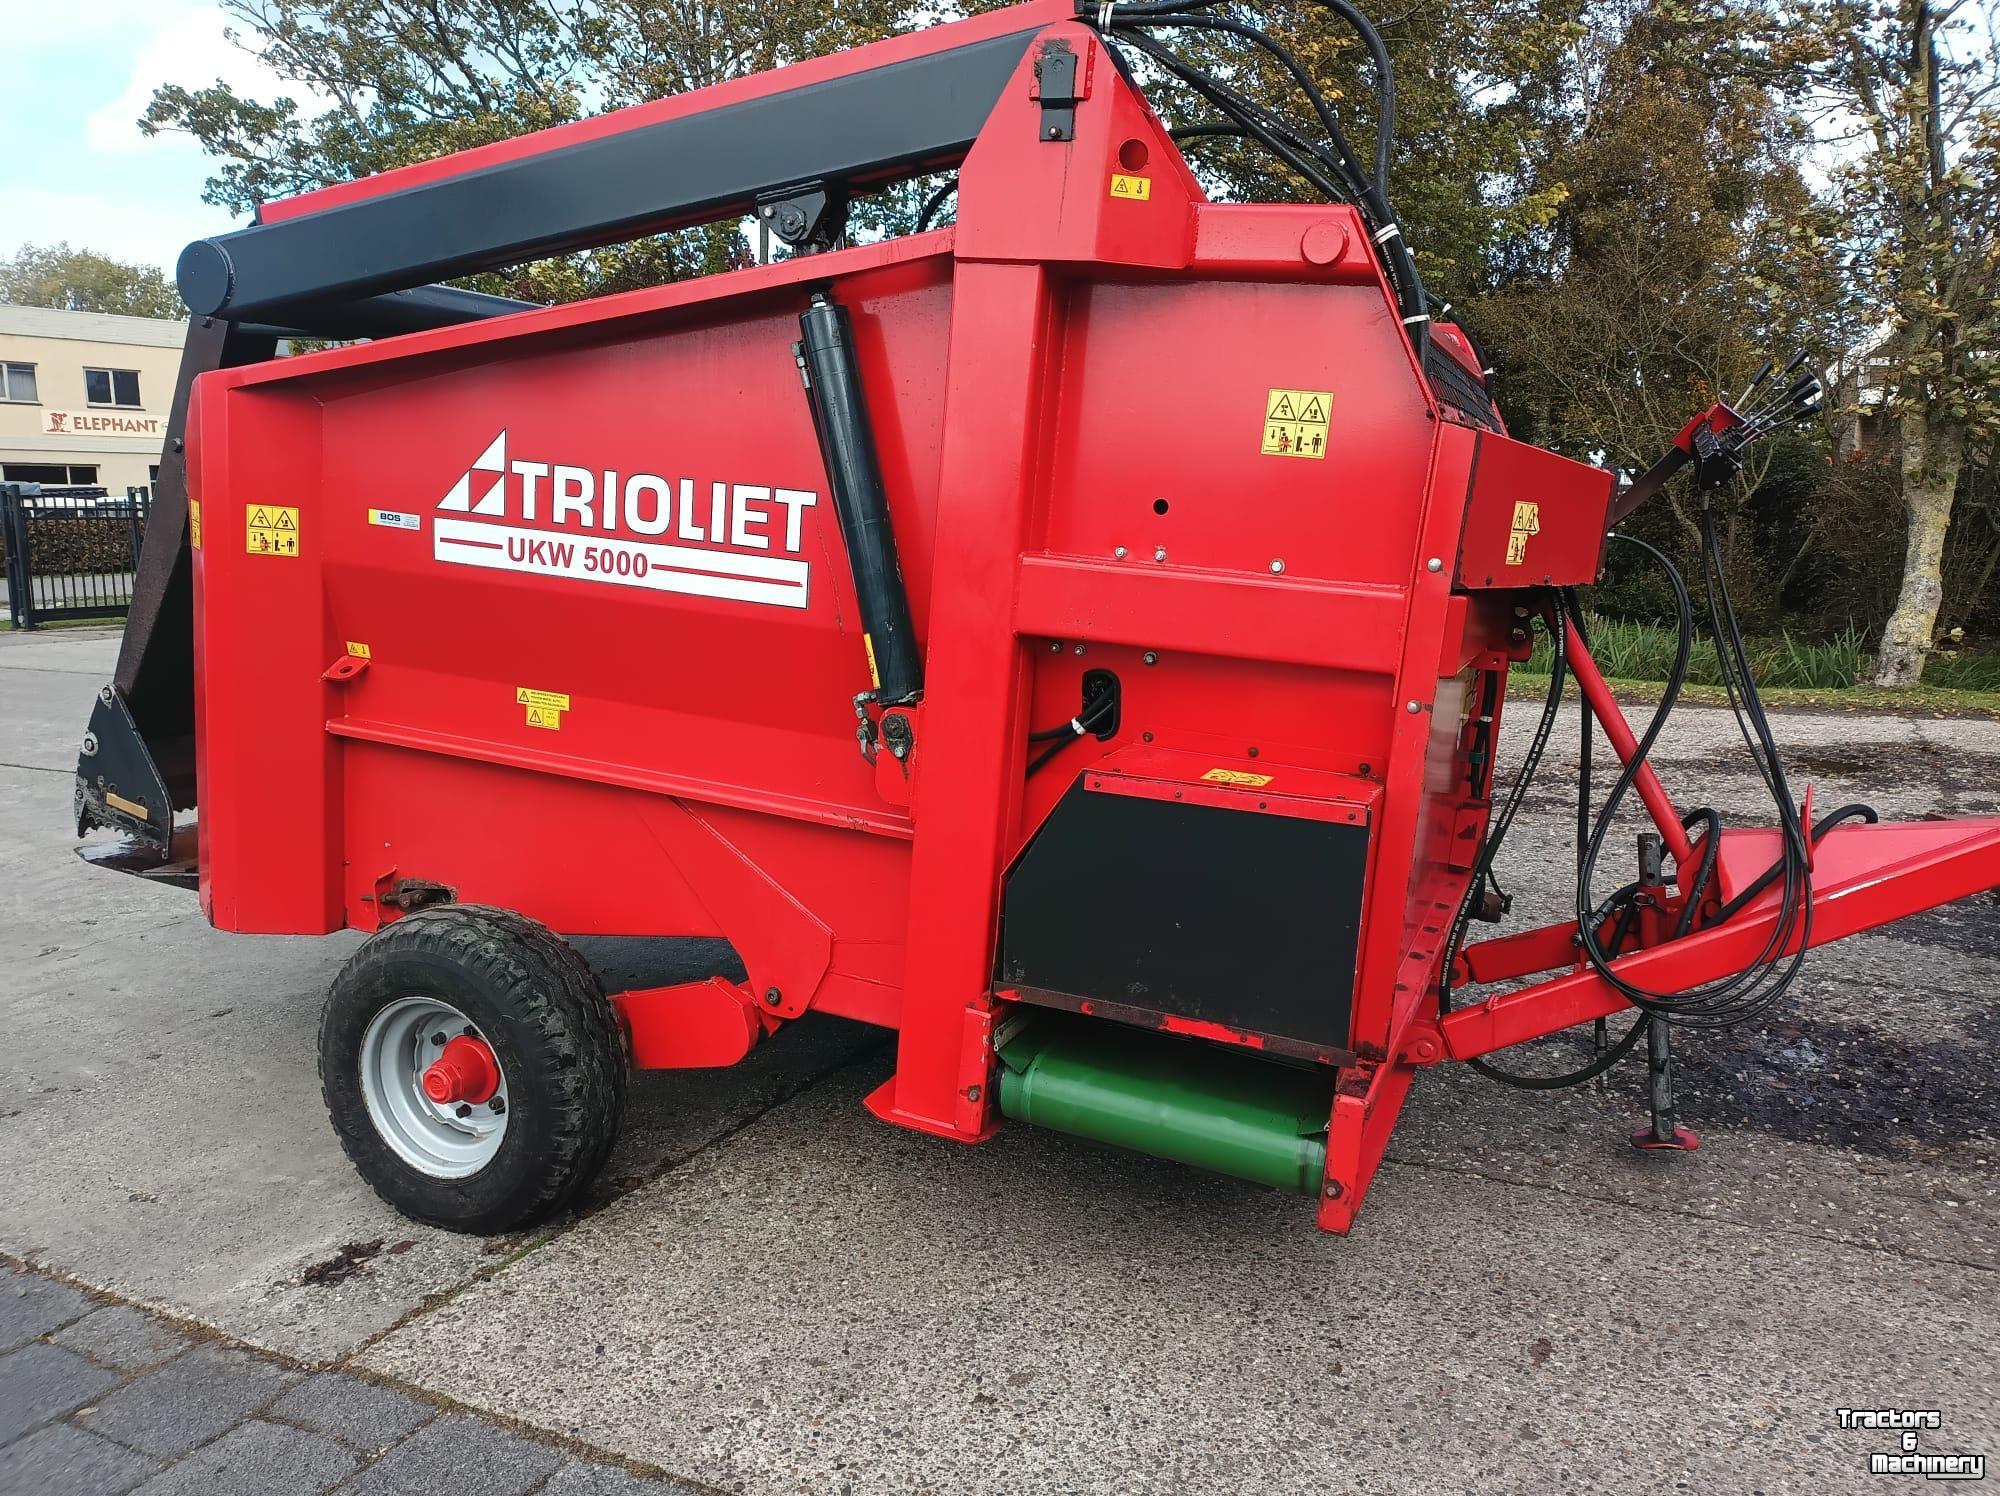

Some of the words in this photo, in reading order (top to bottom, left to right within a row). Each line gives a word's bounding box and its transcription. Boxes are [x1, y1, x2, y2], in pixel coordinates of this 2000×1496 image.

[73, 416, 158, 433] ELEPHANT
[380, 512, 401, 522] BOS
[511, 460, 818, 553] TRIOLIET
[507, 537, 575, 568] UKW
[584, 548, 649, 579] 5000
